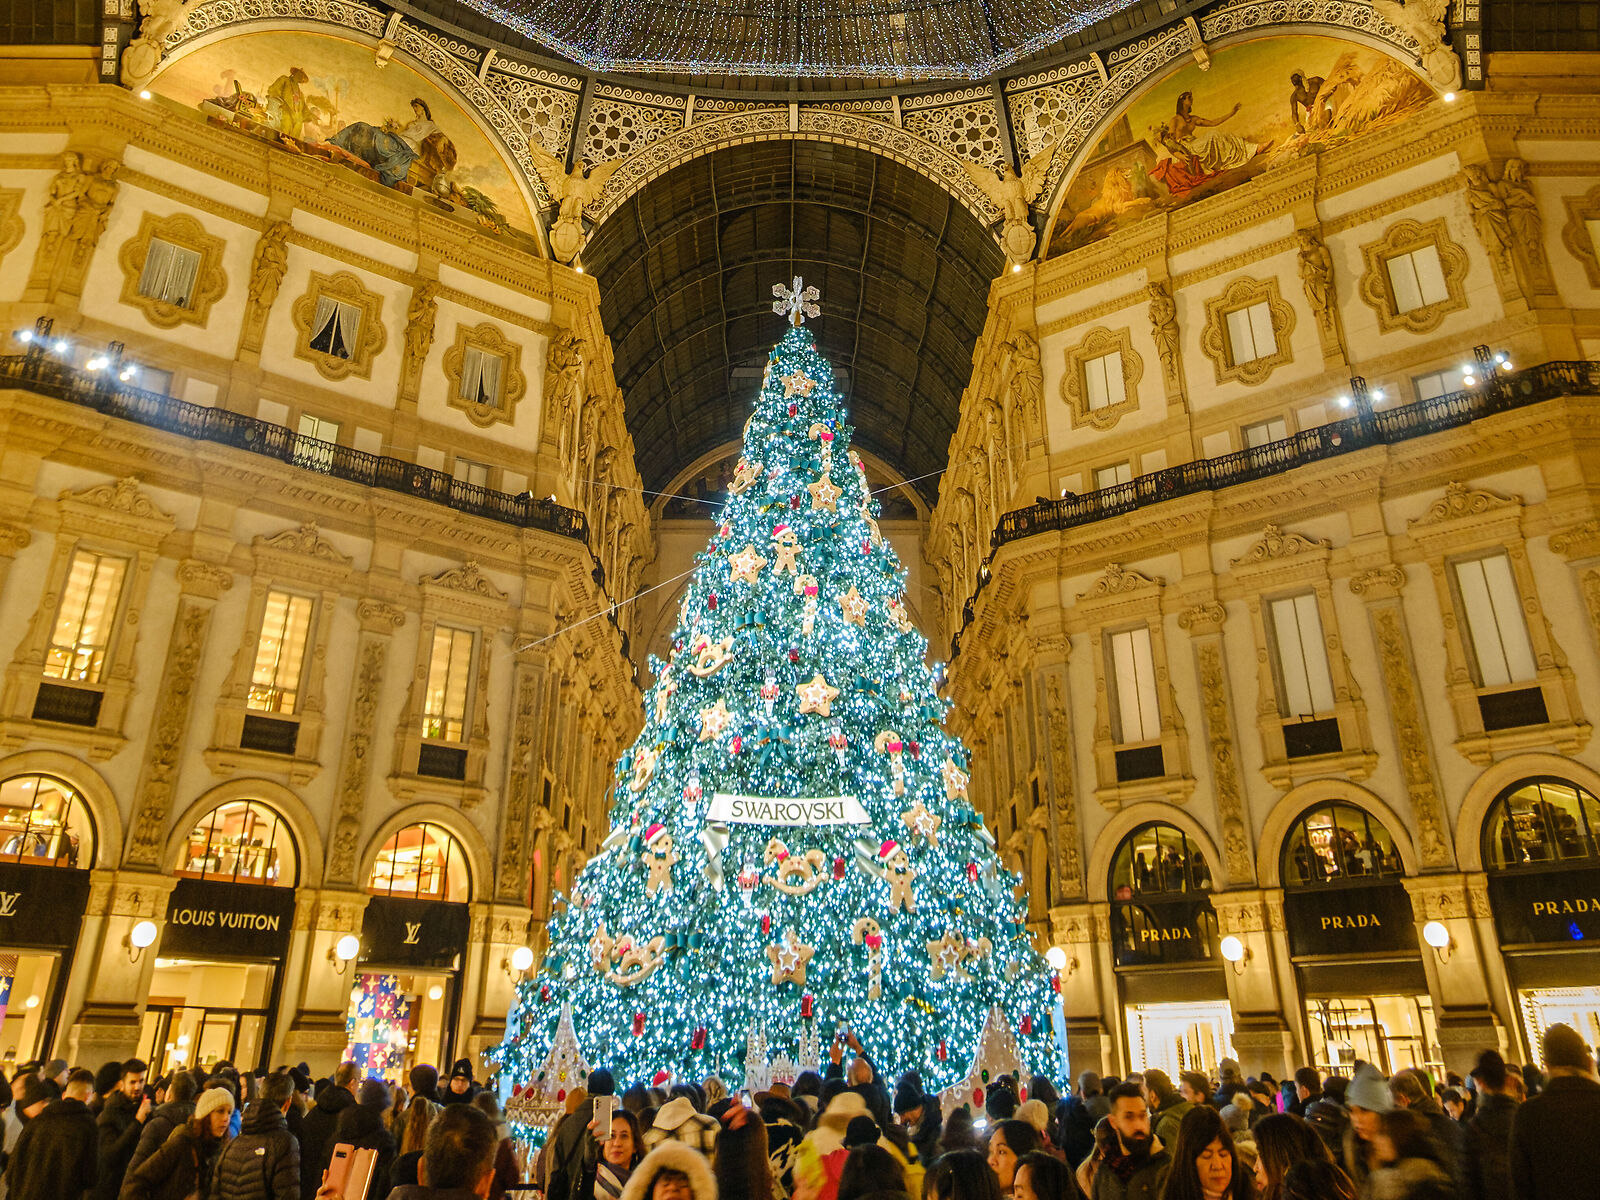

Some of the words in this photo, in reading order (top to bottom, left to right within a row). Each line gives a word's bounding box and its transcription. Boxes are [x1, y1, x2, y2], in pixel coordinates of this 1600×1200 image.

[731, 800, 845, 821] SWAROVSKI
[1532, 898, 1600, 916] PRADA
[172, 908, 216, 927] LOUIS
[219, 912, 280, 932] VUITTON
[1320, 913, 1381, 930] PRADA
[1140, 927, 1192, 942] PRADA
